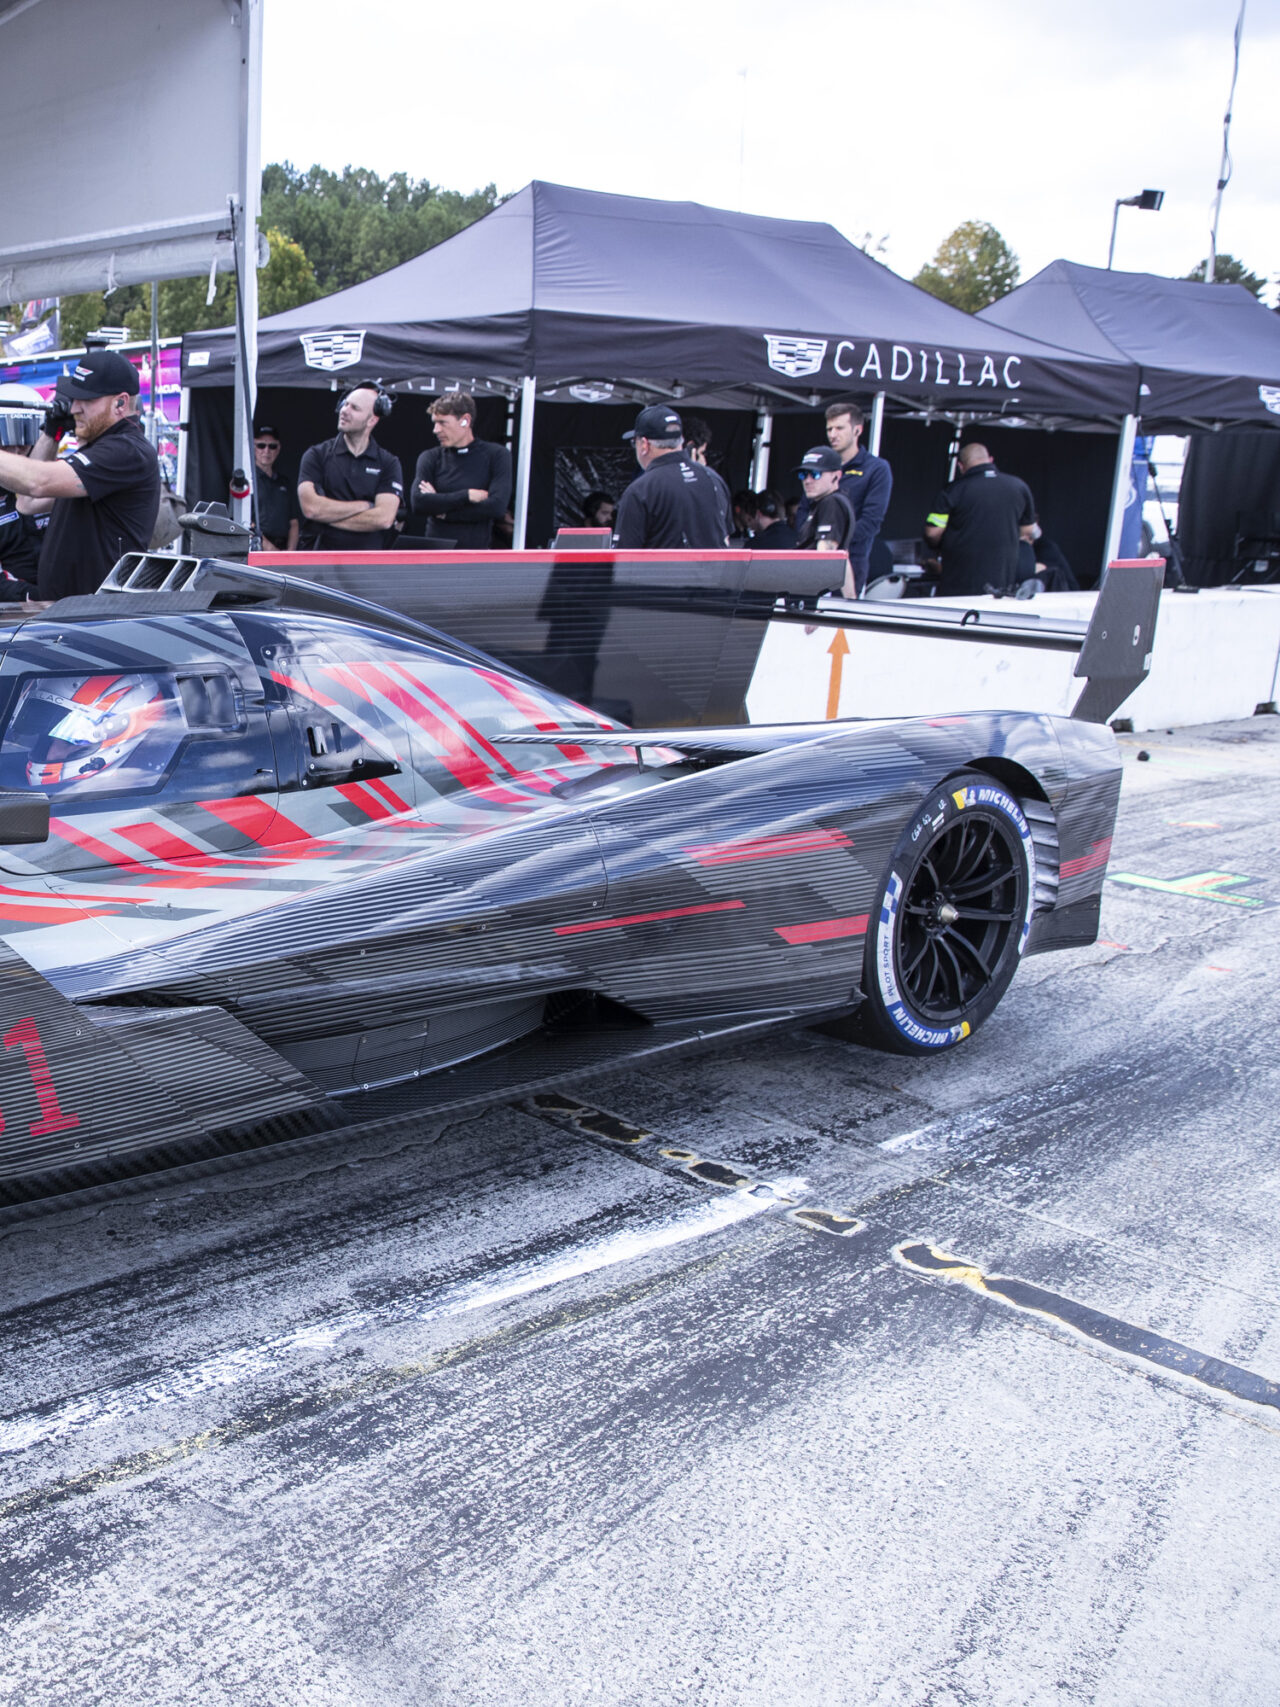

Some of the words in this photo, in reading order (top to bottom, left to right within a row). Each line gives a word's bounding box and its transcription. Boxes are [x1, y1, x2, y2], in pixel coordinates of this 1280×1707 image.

[834, 340, 1021, 388] CADILLAC
[978, 788, 1028, 834] MICHELIN
[893, 1007, 949, 1044] MICHELIN
